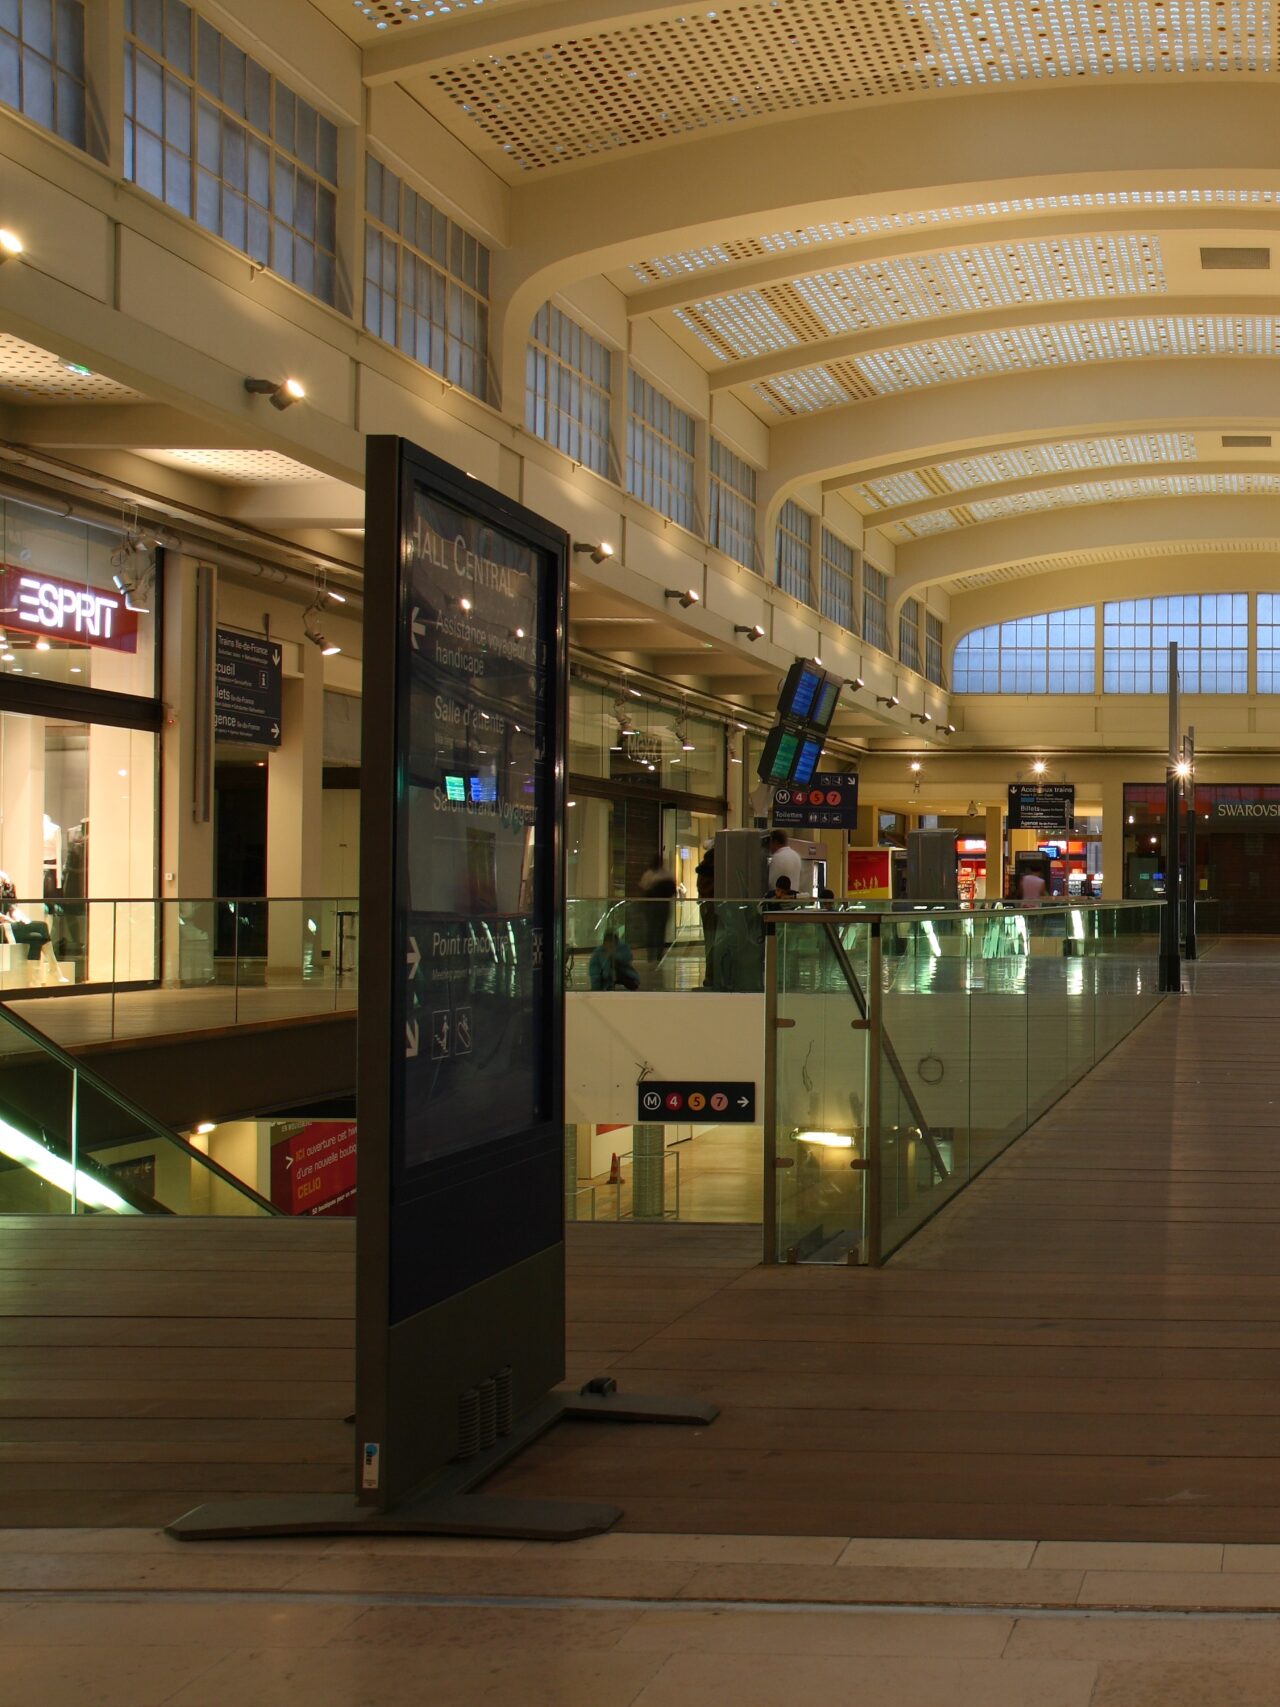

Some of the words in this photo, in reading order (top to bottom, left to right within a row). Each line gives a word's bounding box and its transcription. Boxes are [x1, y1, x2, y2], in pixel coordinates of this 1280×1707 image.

[454, 534, 514, 598] CENTRAL
[19, 577, 118, 639] ESPRIT
[218, 634, 235, 649] Trains
[436, 609, 487, 647] Assistance
[488, 628, 526, 661] voyageur
[434, 695, 460, 724] Salle
[775, 810, 803, 819] Toilettes
[432, 931, 461, 957] Point
[463, 934, 508, 955] rencontre
[306, 1136, 337, 1157] ouverture
[337, 1130, 347, 1143] cet
[296, 1165, 313, 1180] d'une
[314, 1151, 338, 1172] nouvelle
[297, 1176, 321, 1199] CELIO
